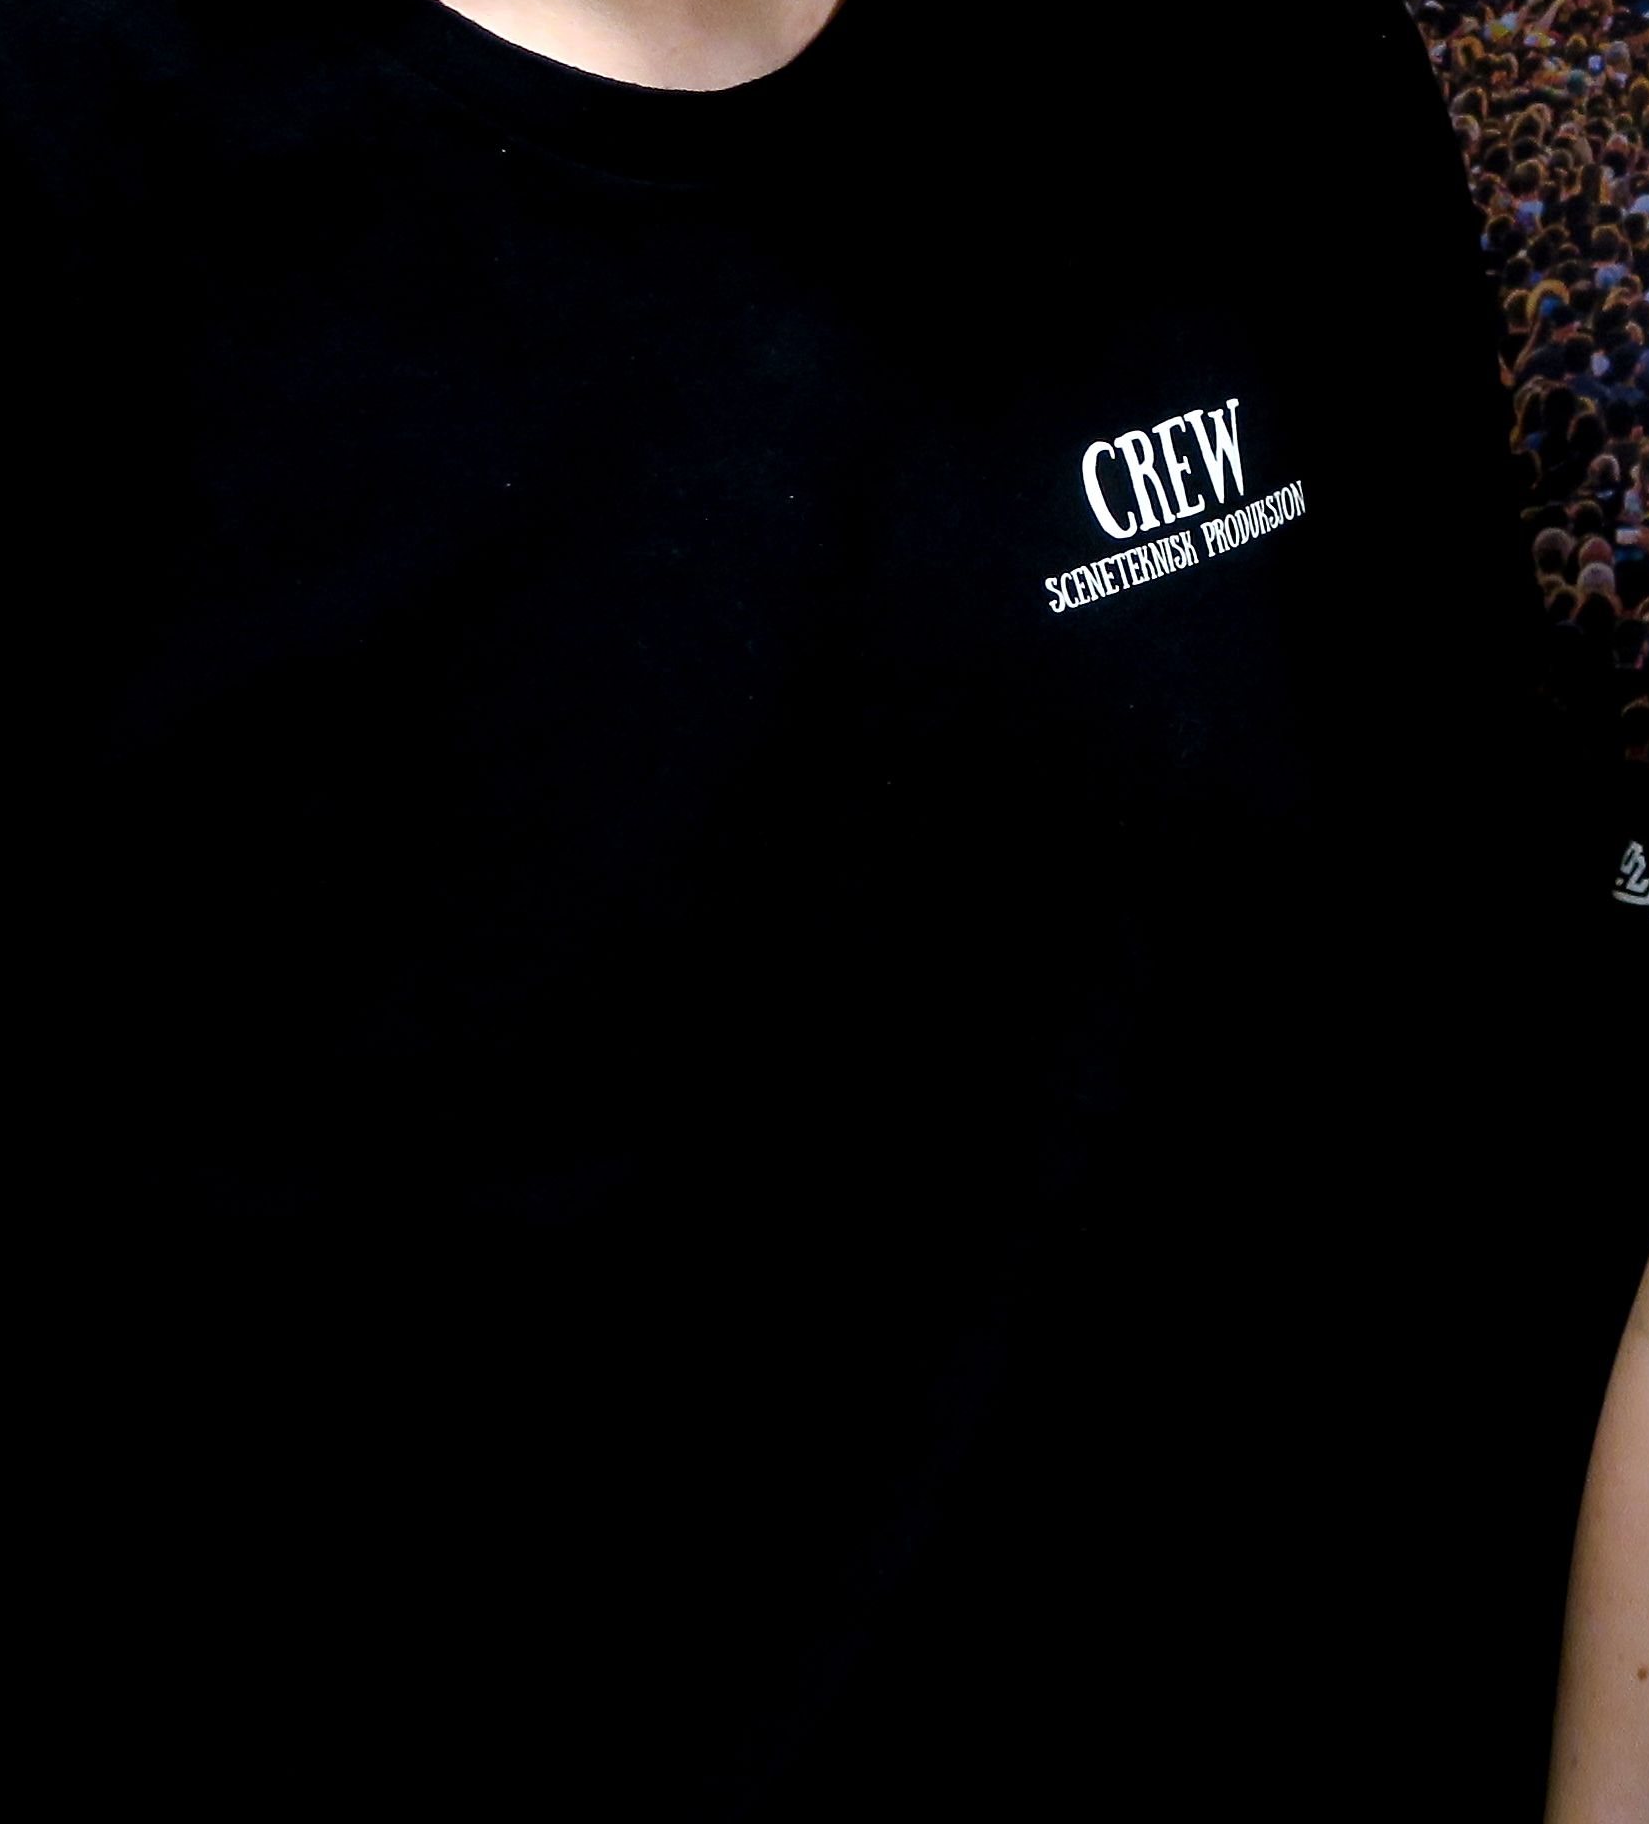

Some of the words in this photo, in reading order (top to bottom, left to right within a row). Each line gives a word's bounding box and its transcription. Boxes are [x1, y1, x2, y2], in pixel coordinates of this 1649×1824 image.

[1082, 398, 1244, 539] CREW
[1045, 530, 1199, 613] SCENETEKNISK
[1200, 480, 1306, 558] PRODUKSJON
